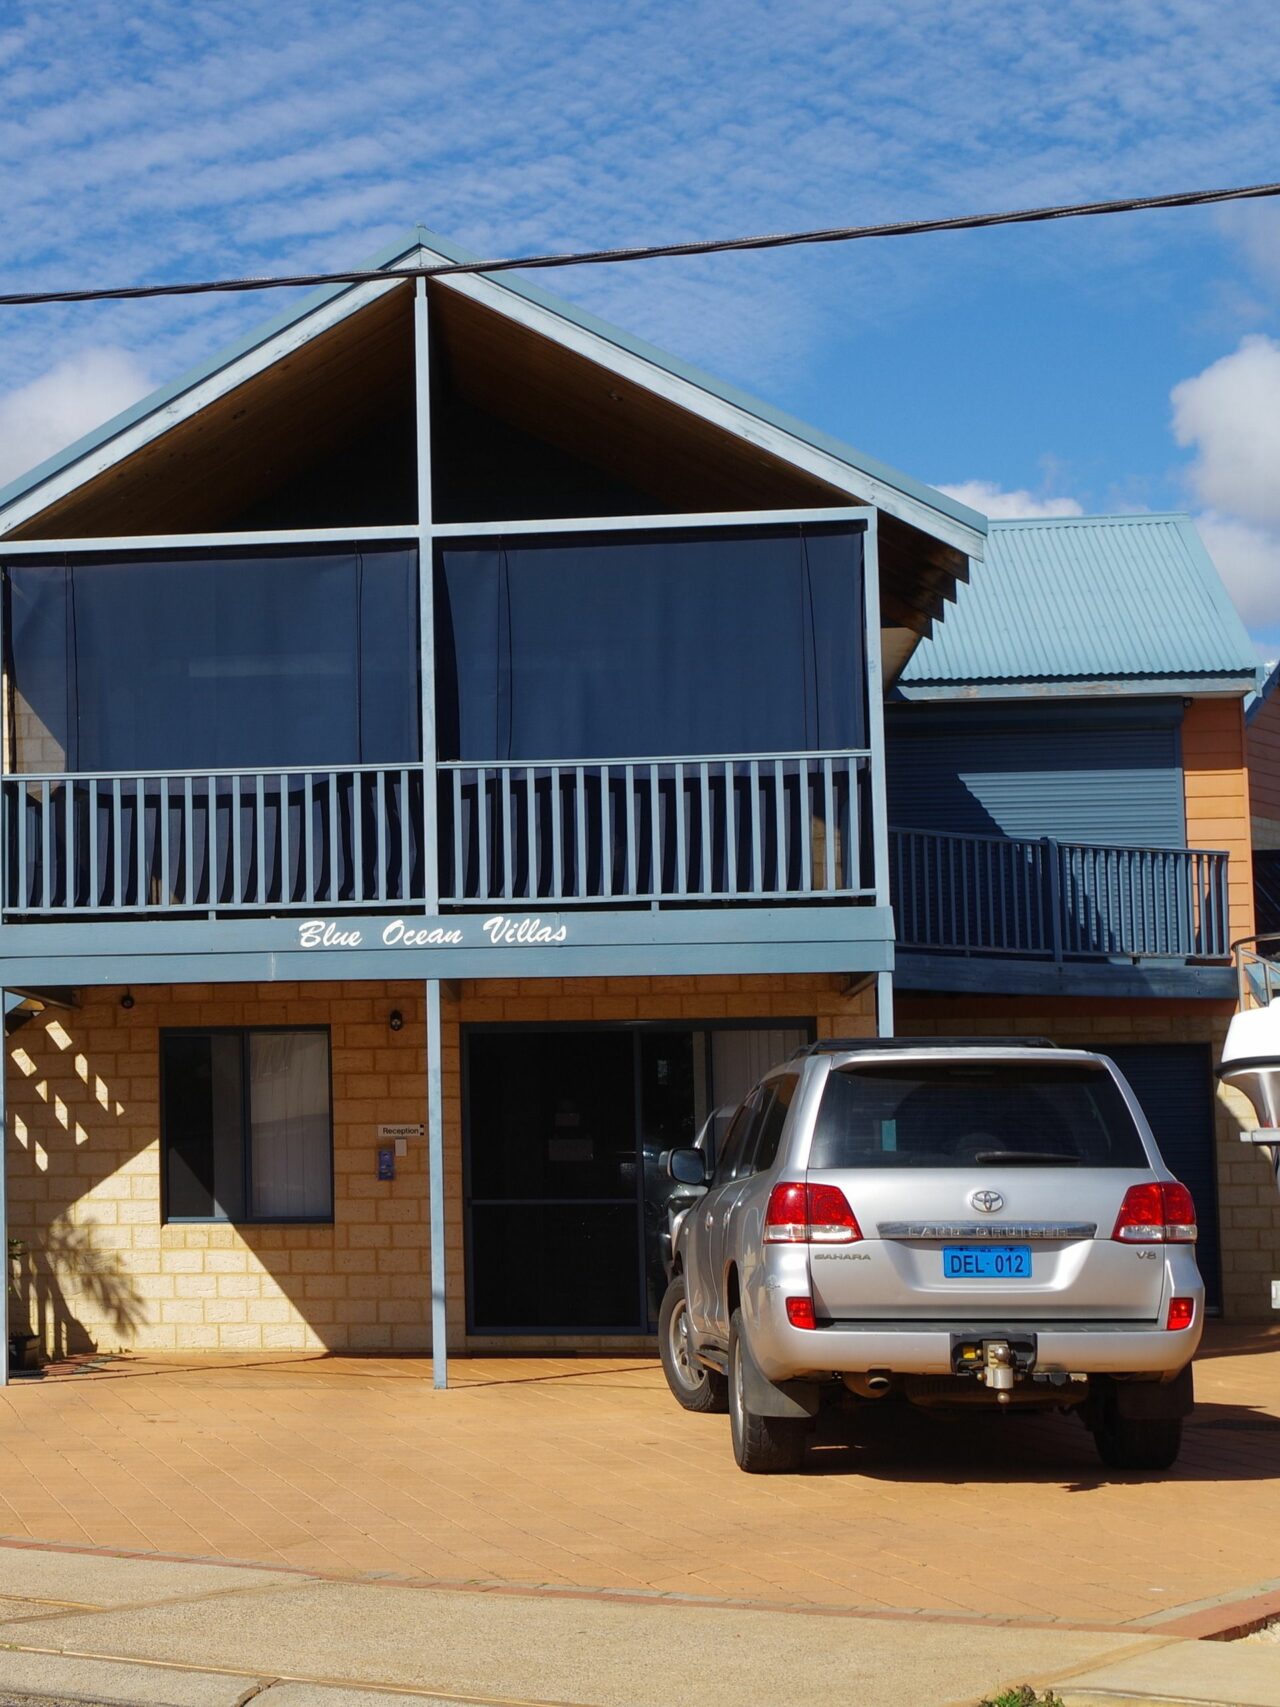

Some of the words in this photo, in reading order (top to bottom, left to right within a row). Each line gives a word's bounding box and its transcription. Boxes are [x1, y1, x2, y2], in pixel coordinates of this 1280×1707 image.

[298, 919, 363, 948] Blue
[382, 919, 463, 946] Ocean
[483, 915, 568, 944] Villas
[382, 1127, 419, 1136] Reception
[814, 1253, 872, 1261] SAHARA
[1135, 1251, 1158, 1260] V8
[950, 1254, 985, 1274] DEL
[995, 1254, 1024, 1274] 012
